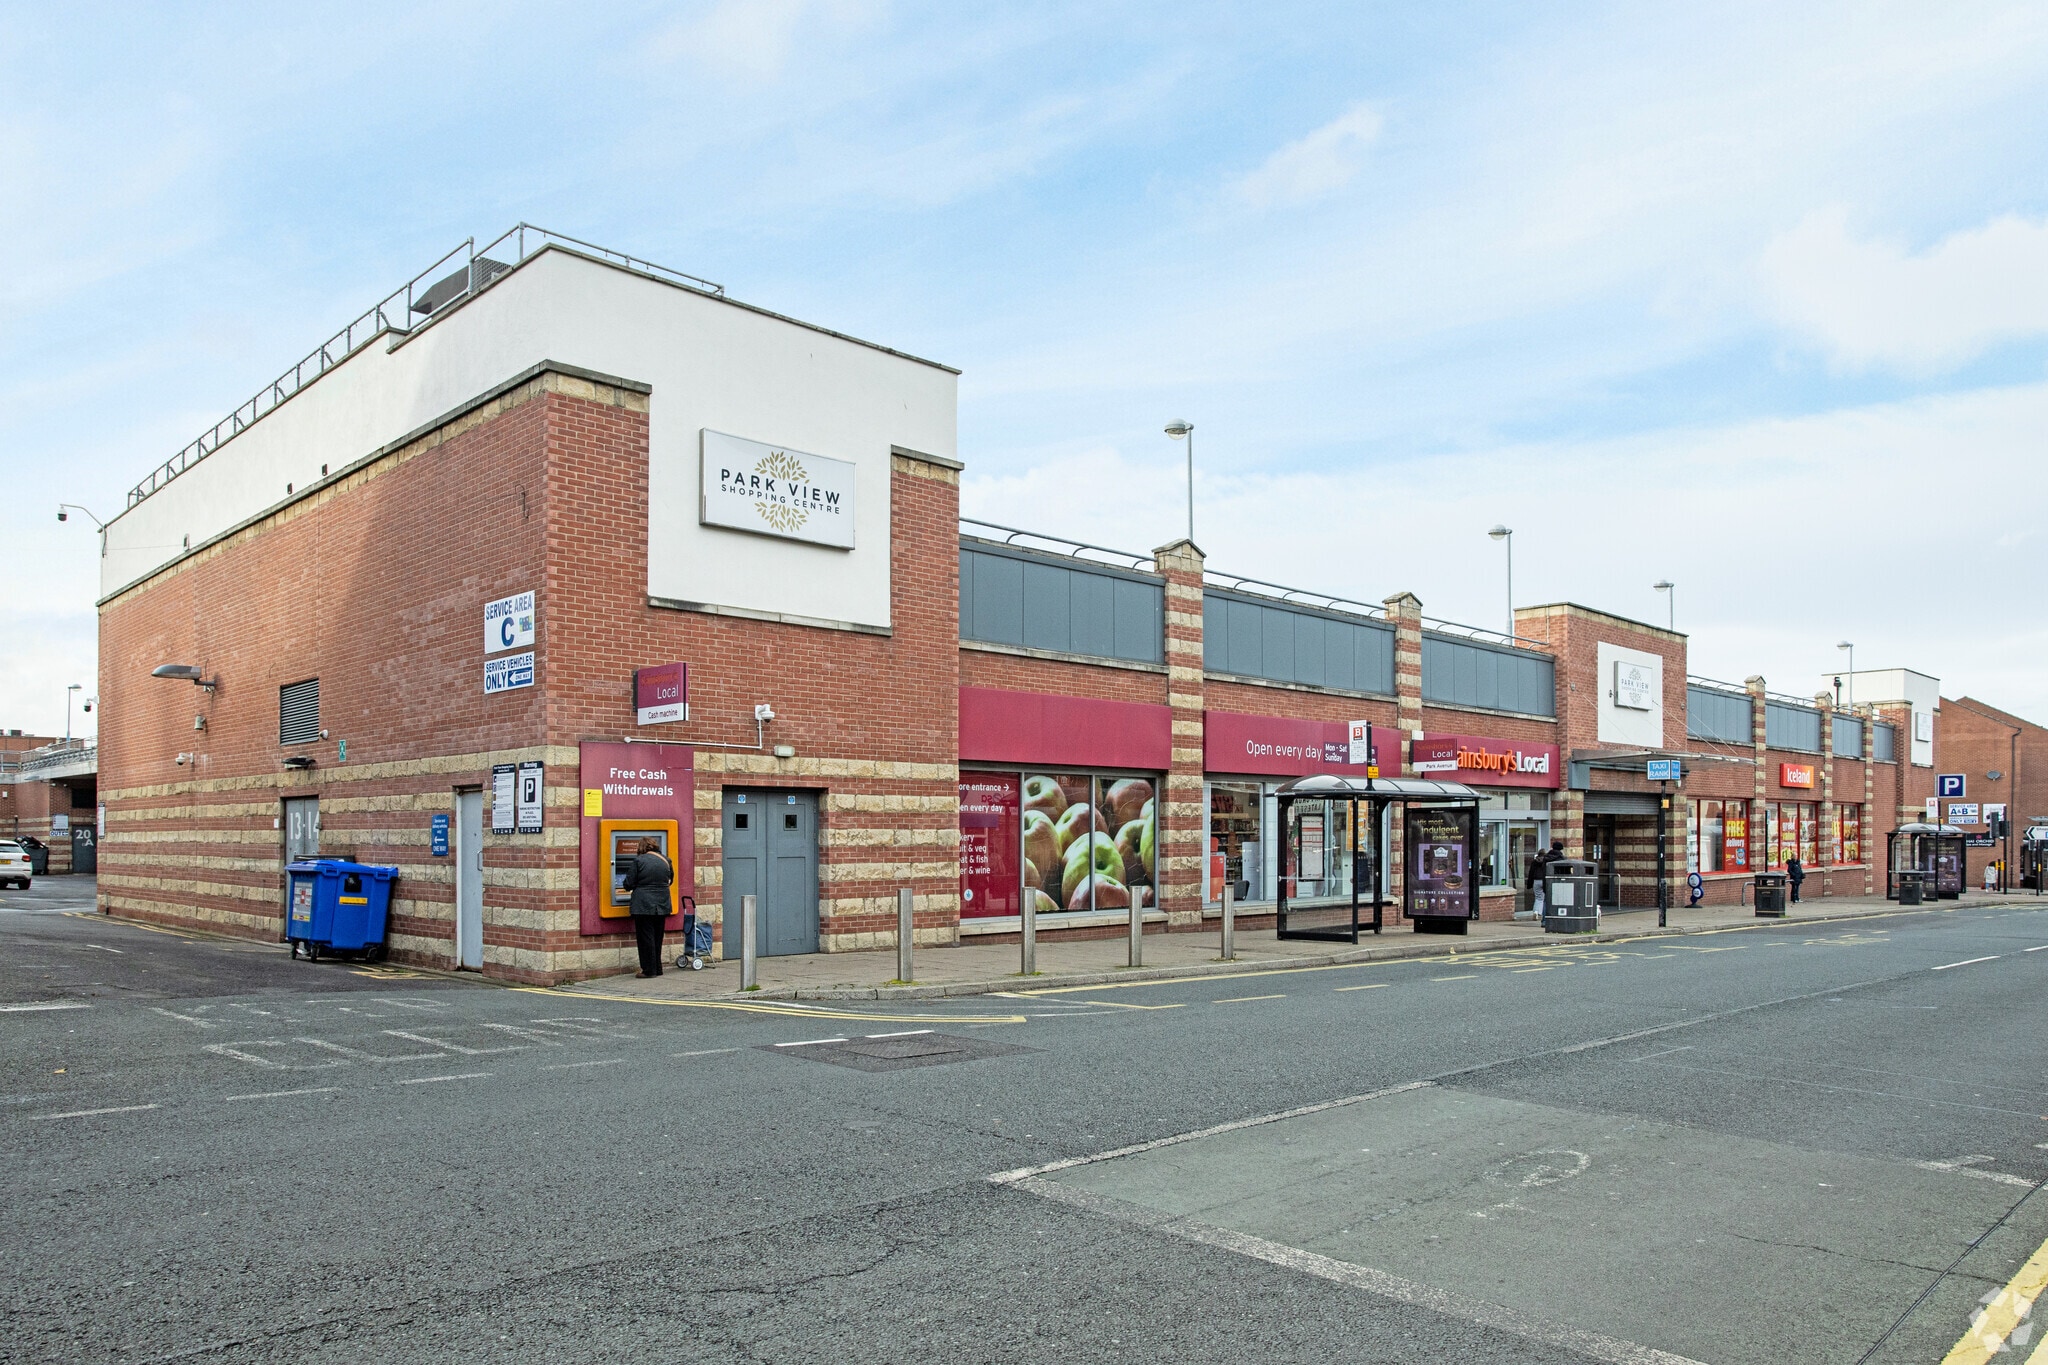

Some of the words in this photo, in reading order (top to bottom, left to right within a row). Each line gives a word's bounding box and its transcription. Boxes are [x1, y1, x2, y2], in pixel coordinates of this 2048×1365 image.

[721, 468, 775, 492] PARK
[788, 483, 840, 505] VIEW
[721, 484, 786, 504] SHOPPING
[794, 499, 840, 515] CENTRE
[485, 600, 512, 620] SERVICE
[514, 594, 532, 613] AREA
[501, 616, 515, 647] C
[485, 660, 506, 673] SERVICE
[506, 654, 532, 670] VEHICLES
[485, 671, 507, 690] ONLY
[657, 684, 679, 700] Local
[648, 711, 659, 719] Cash
[659, 708, 678, 718] machine
[1354, 728, 1361, 737] B
[1246, 740, 1273, 757] Open
[1275, 745, 1303, 760] every
[1305, 745, 1323, 761] day
[1325, 743, 1336, 752] Mon
[1339, 744, 1348, 753] Sat
[1432, 750, 1453, 758] Local
[1324, 752, 1343, 763] Sunday
[1457, 746, 1517, 776] ainsbury's
[1516, 751, 1549, 773] Local
[610, 767, 636, 779] Free
[639, 768, 667, 780] Cash
[1787, 767, 1811, 784] Iceland
[525, 780, 534, 801] P
[603, 783, 674, 796] Withdrawals
[959, 783, 970, 791] ore
[971, 783, 1002, 791] entrance
[1944, 777, 1959, 795] P
[970, 804, 989, 814] every
[990, 804, 1003, 813] day
[75, 829, 91, 839] 20
[1421, 825, 1460, 836] indulgent
[1726, 820, 1745, 837] FREE
[959, 833, 975, 843] kery
[974, 845, 987, 854] veg
[959, 855, 968, 863] at
[969, 855, 975, 863] &
[975, 855, 989, 863] fish
[968, 867, 974, 875] &
[975, 867, 991, 875] wine
